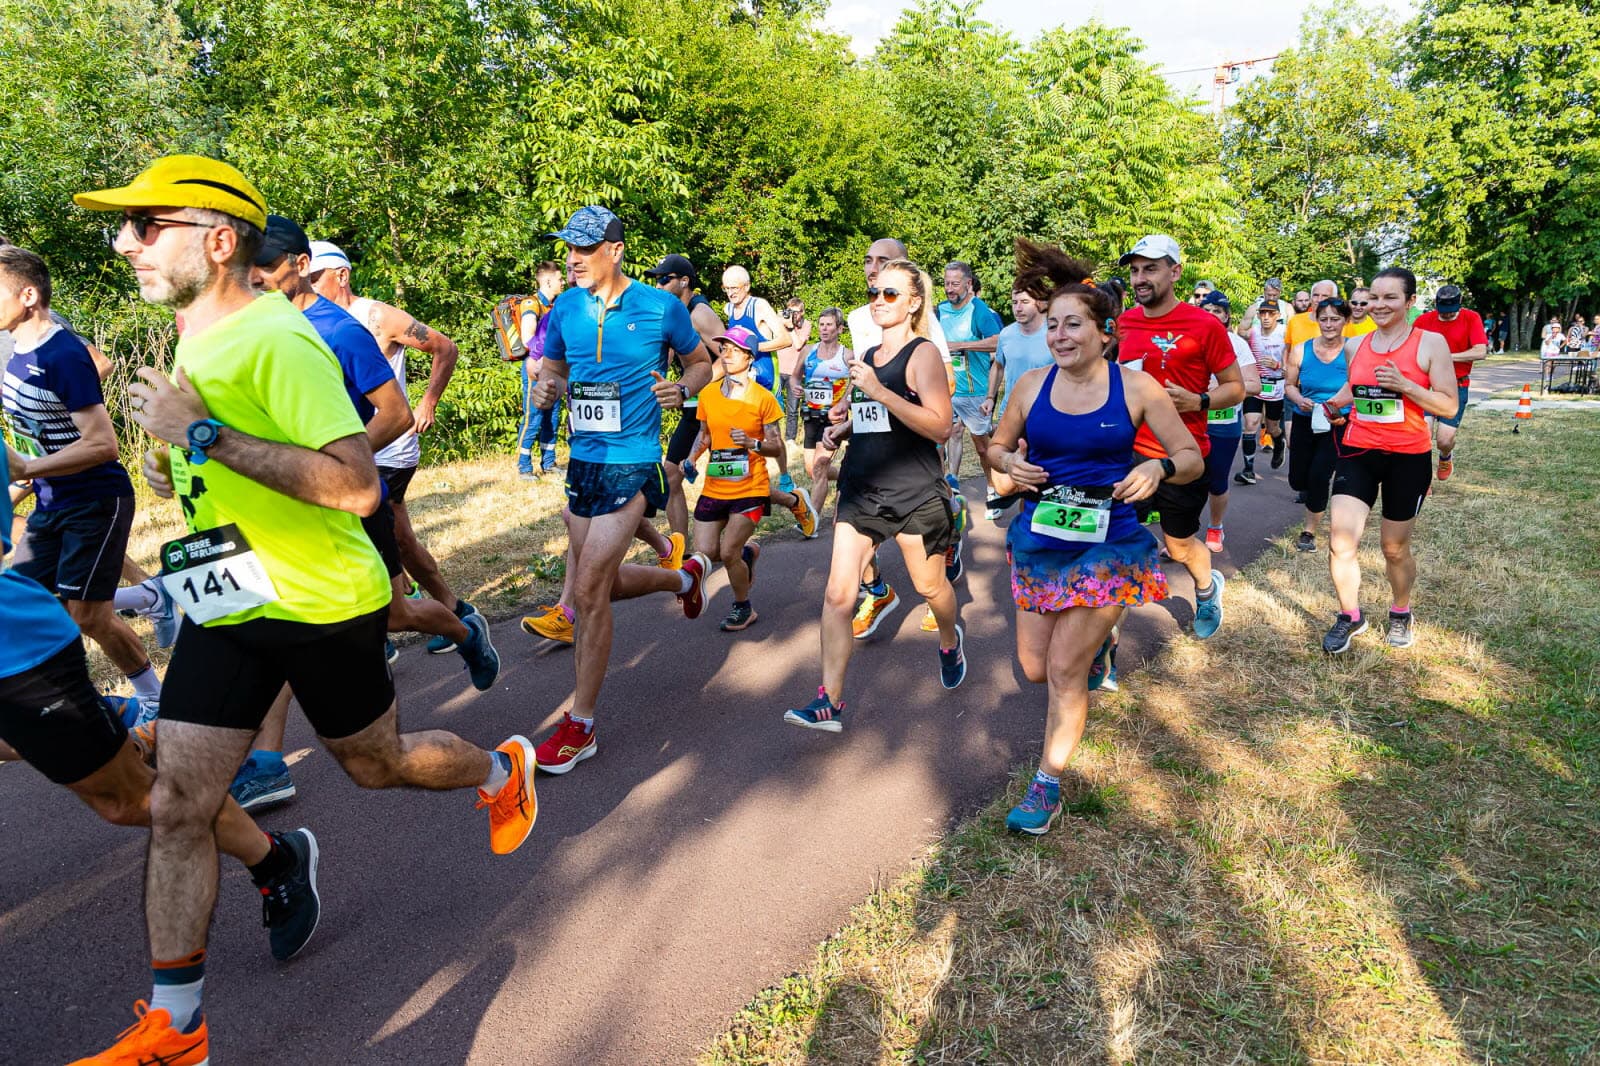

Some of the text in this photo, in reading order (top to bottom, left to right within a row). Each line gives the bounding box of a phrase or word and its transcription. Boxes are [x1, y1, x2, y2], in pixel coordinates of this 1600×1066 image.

[809, 391, 826, 400] 126
[577, 404, 604, 421] 106
[858, 406, 878, 422] 145
[1215, 410, 1227, 419] 51
[1366, 401, 1384, 414] 19
[718, 464, 734, 476] 39
[1054, 508, 1082, 529] 32
[184, 537, 212, 553] TERRE
[199, 541, 237, 559] RUNNG
[168, 550, 184, 563] TDR
[183, 567, 241, 603] 141
